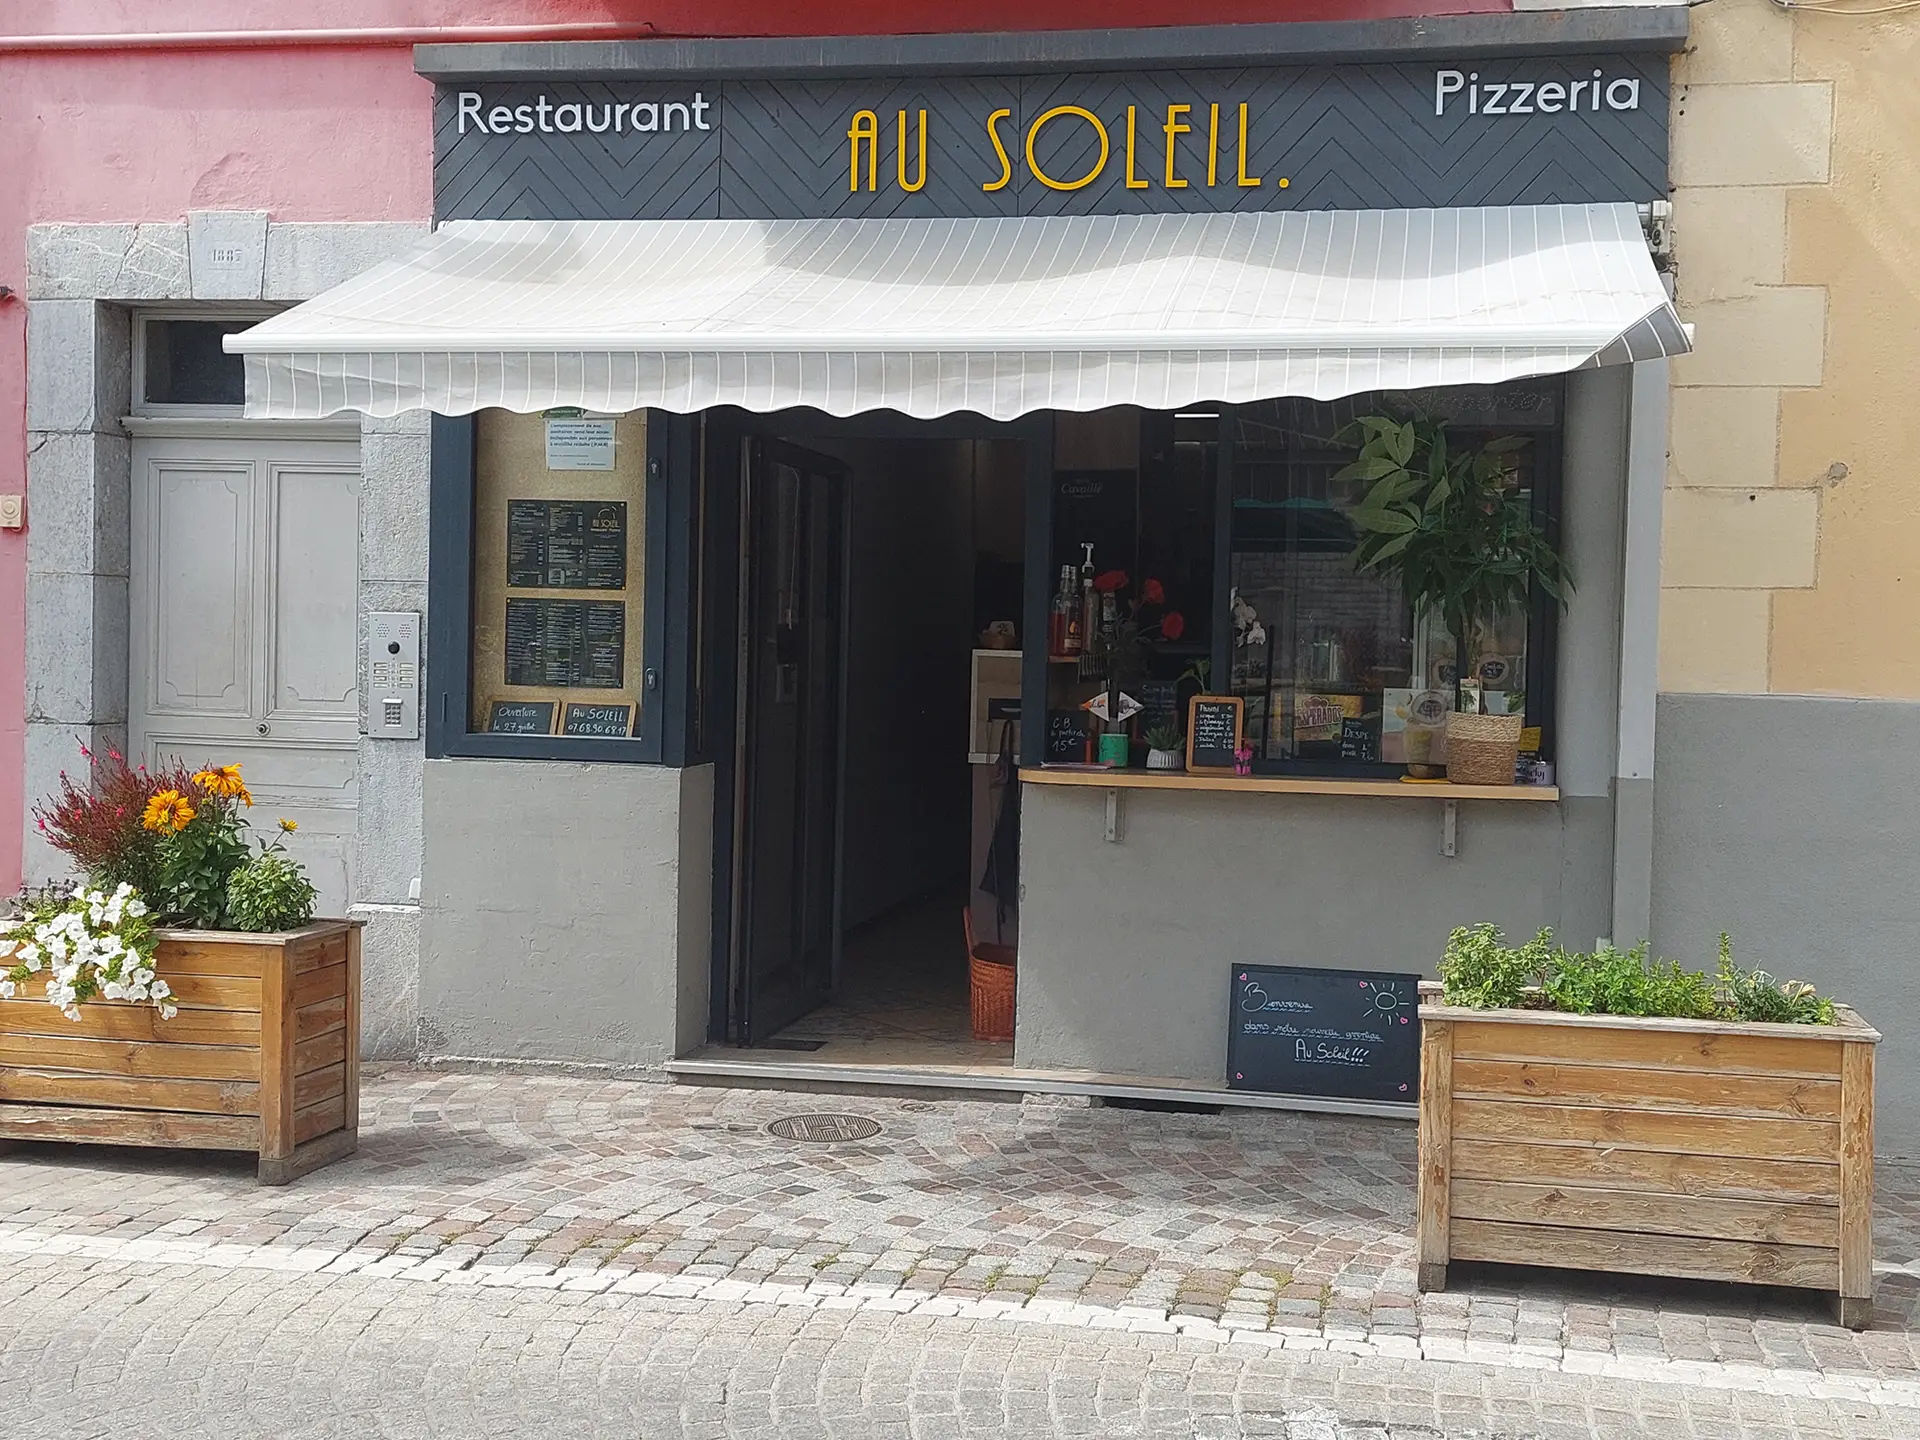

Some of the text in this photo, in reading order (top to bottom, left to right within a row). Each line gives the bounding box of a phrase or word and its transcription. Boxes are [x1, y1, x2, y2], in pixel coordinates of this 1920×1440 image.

[457, 91, 710, 135] Restaurant
[1435, 68, 1640, 116] Pizzeria
[847, 108, 928, 193] AU
[503, 722, 517, 732] 27
[1295, 1038, 1313, 1059] Au
